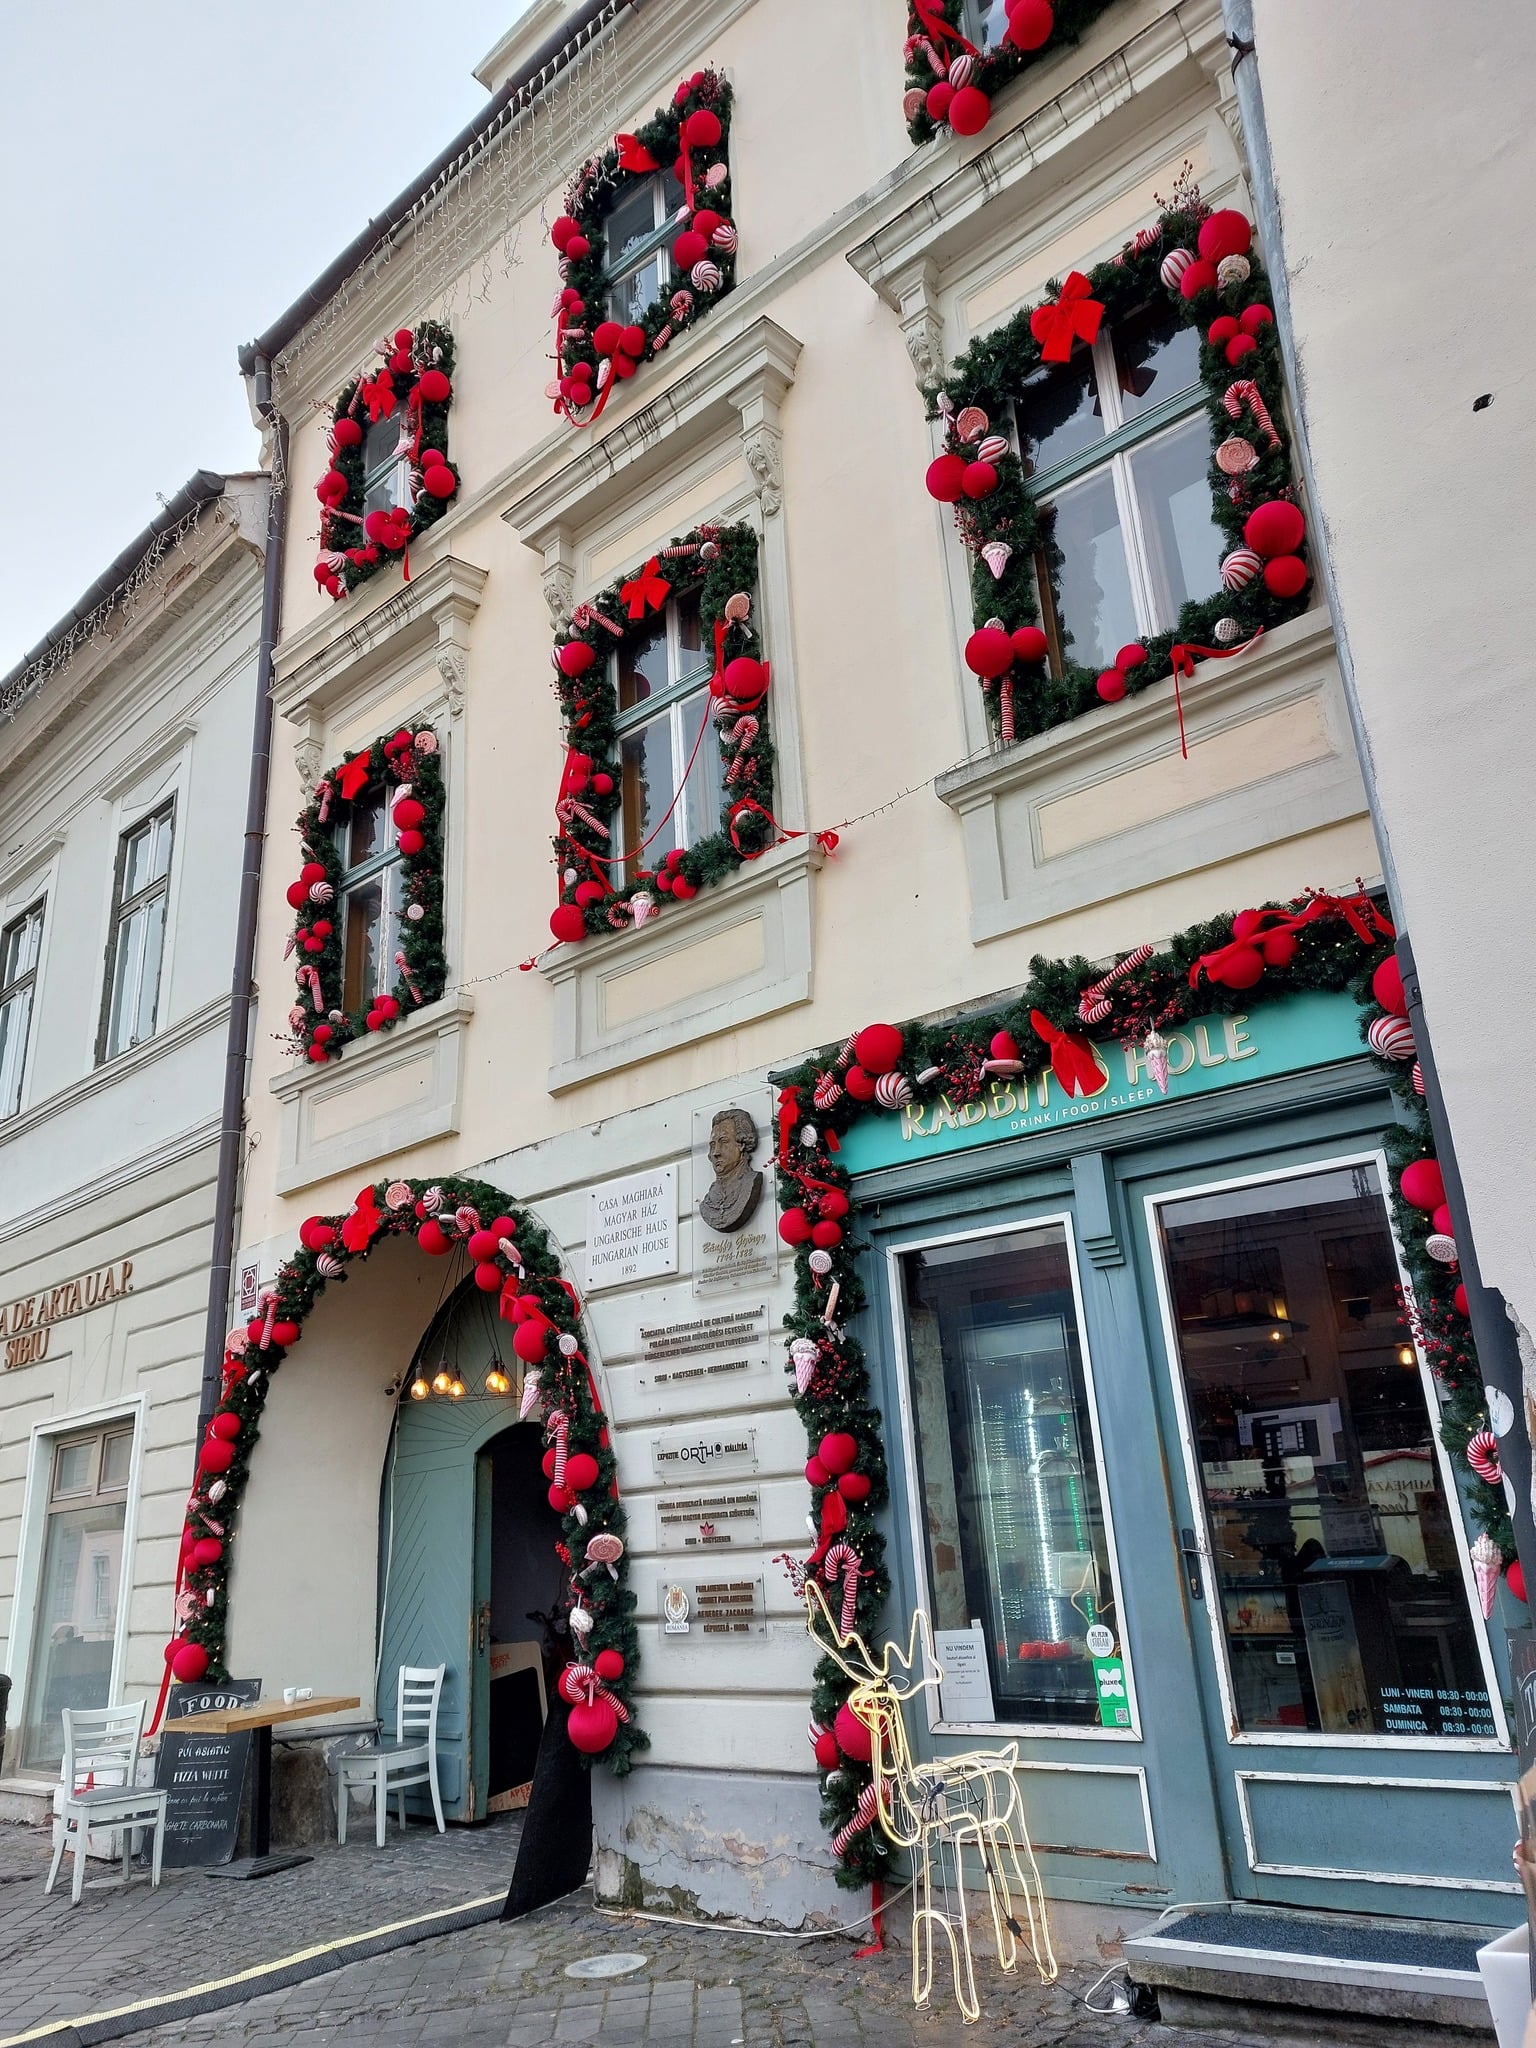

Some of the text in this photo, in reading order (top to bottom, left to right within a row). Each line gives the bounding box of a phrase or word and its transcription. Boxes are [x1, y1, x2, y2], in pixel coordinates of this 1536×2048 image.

[1124, 1014, 1259, 1086] HOLE
[1011, 1112, 1051, 1130] DRINK
[1062, 1101, 1099, 1118] FOOD
[1110, 1088, 1154, 1107] SLEEP
[598, 1197, 618, 1212] CASA
[604, 1202, 658, 1228] MAGYAR HÁZ
[593, 1219, 668, 1248] UNGARISCHE HAUS
[592, 1237, 670, 1266] HUNGARIAN HOUSE
[622, 1264, 636, 1275] 1892
[11, 1297, 36, 1333] DE
[35, 1279, 83, 1324] ARTA
[4, 1327, 51, 1369] SIBIU
[187, 1695, 239, 1713] FOOD
[1381, 1688, 1400, 1698] LUNI
[1406, 1689, 1434, 1700] VINERI
[1437, 1690, 1460, 1700] 08:30
[1466, 1691, 1488, 1702] 00:00
[1384, 1704, 1422, 1716] SAMBATA
[1440, 1706, 1463, 1716] 08:30
[1469, 1708, 1492, 1718] 00:00
[1386, 1720, 1428, 1732] DUMINICA
[1442, 1723, 1466, 1734] 08:30
[1472, 1724, 1494, 1735] 00:00
[195, 1745, 230, 1758] ASIATIC
[173, 1769, 198, 1783] PIZZA
